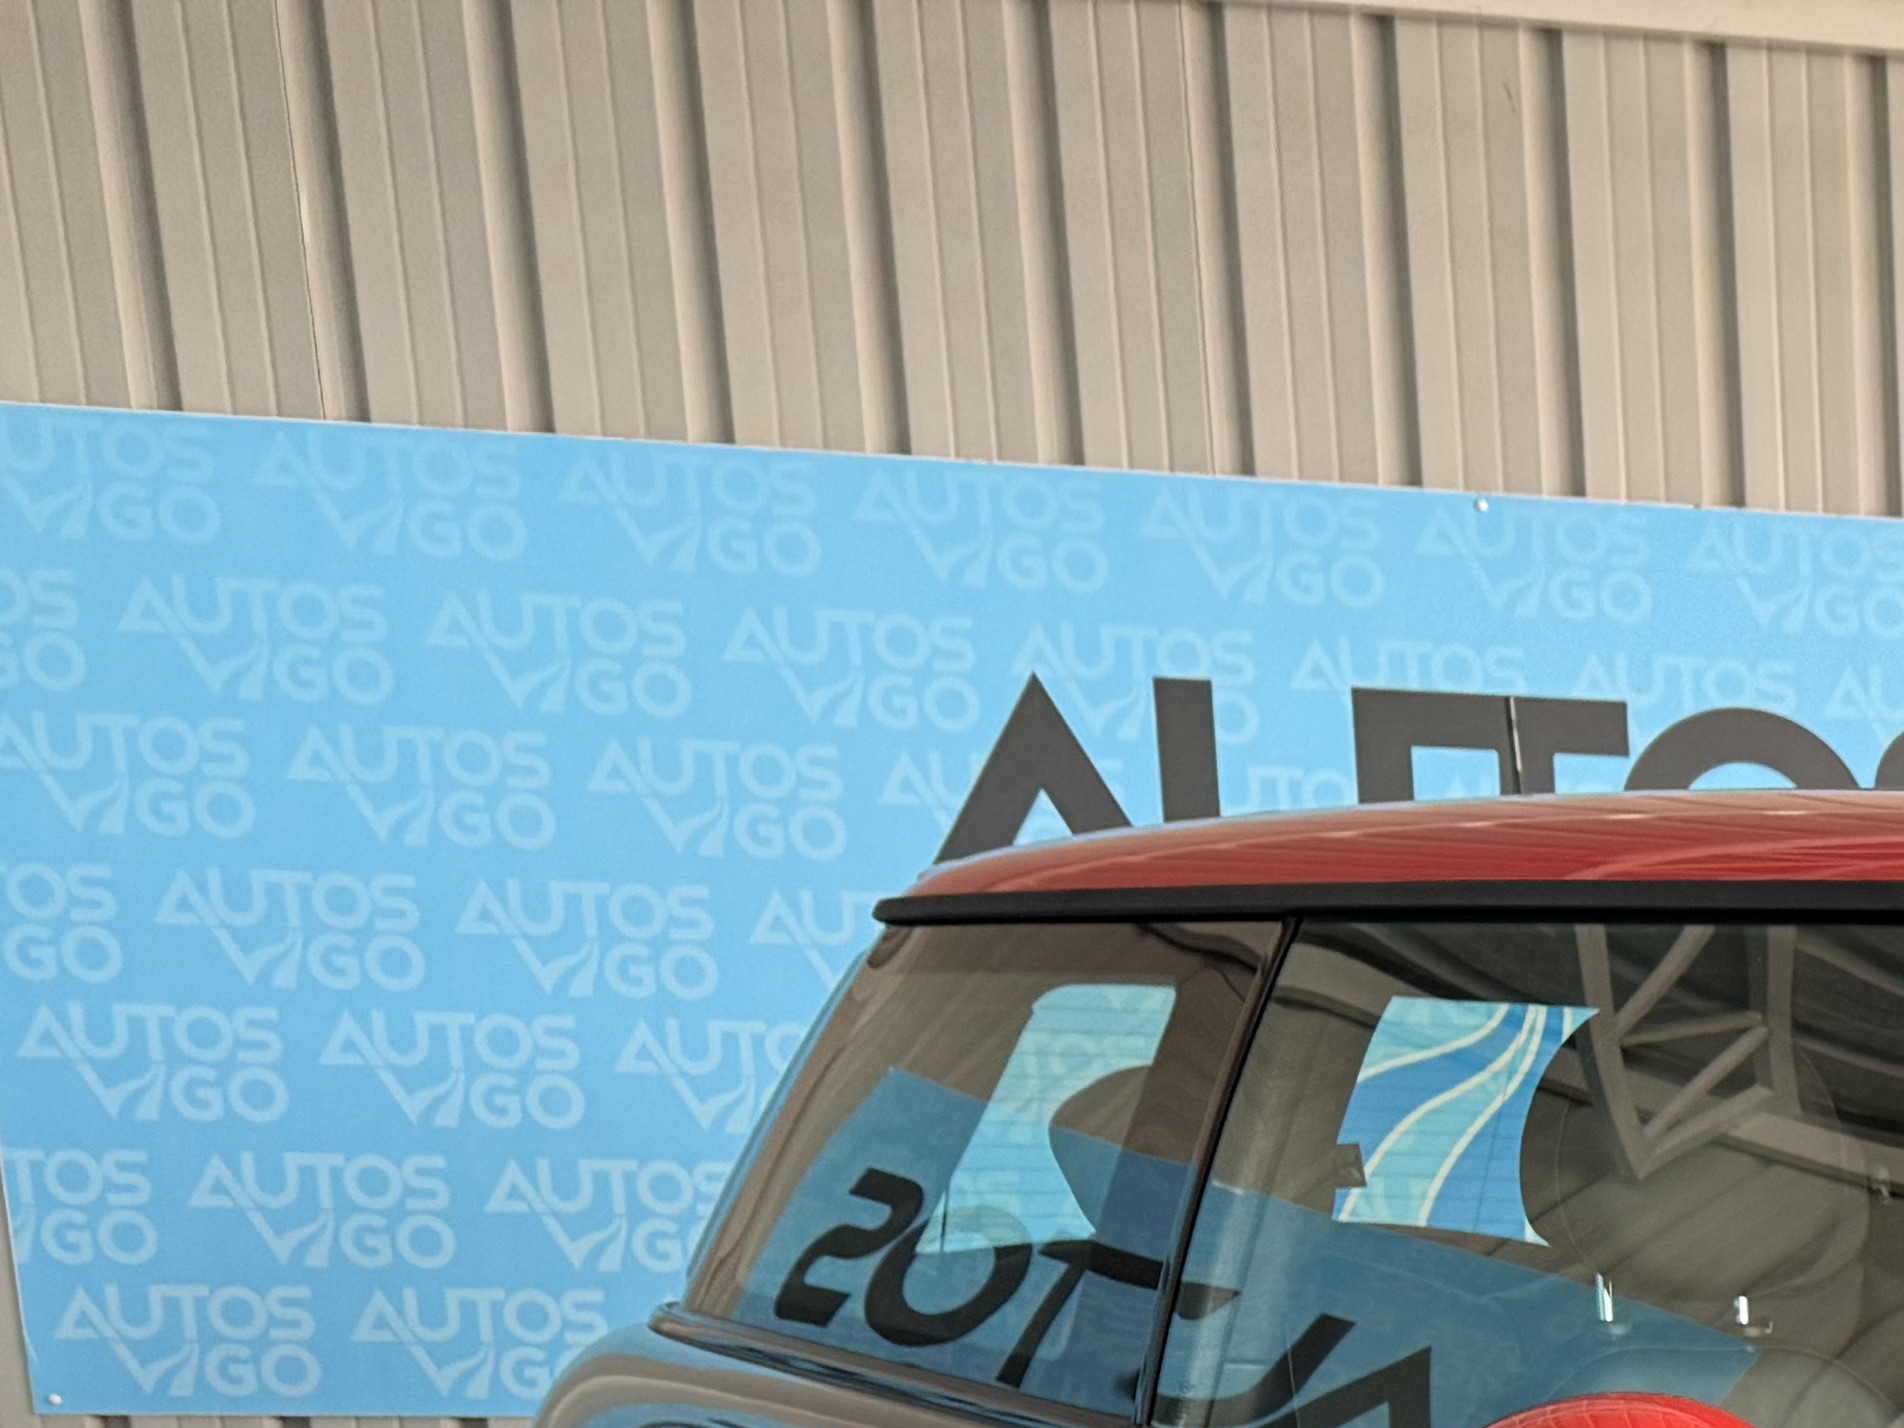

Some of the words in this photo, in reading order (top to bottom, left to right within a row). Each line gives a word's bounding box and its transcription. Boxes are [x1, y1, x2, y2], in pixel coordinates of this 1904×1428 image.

[0, 415, 215, 483] UTOS
[255, 430, 521, 499] AUTOS
[5, 477, 220, 545] VIGO
[559, 447, 816, 519] AUTOS
[851, 466, 1105, 534] AUTOS
[311, 489, 527, 561] VIGO
[613, 509, 822, 577] VIGO
[1139, 483, 1381, 550] AUTOS
[1415, 503, 1651, 567] AUTOS
[906, 522, 1109, 594] VIGO
[1192, 543, 1386, 609] VIGO
[117, 574, 388, 643] AUTOS
[424, 589, 687, 659] AUTOS
[1468, 560, 1653, 624] VIGO
[177, 632, 396, 705] VIGO
[721, 606, 976, 672] AUTOS
[483, 649, 692, 718] VIGO
[776, 663, 981, 732] VIGO
[286, 722, 552, 789] AUTOS
[586, 736, 843, 801] AUTOS
[38, 773, 256, 839] VIGO
[345, 782, 556, 849] VIGO
[642, 795, 847, 861] VIGO
[153, 865, 420, 933] AUTOS
[455, 879, 716, 941] AUTOS
[214, 925, 426, 991] VIGO
[512, 933, 720, 1000] VIGO
[17, 1002, 283, 1064] AUTOS
[318, 1010, 582, 1072] AUTOS
[615, 1017, 806, 1076] AUTO
[77, 1061, 290, 1124] VIGO
[375, 1067, 586, 1130] VIGO
[189, 1152, 450, 1211] AUTOS
[247, 1207, 456, 1270] VIGO
[55, 1284, 316, 1341] AUTOS
[350, 1286, 609, 1344] AUTOS
[114, 1338, 321, 1397] VIGO
